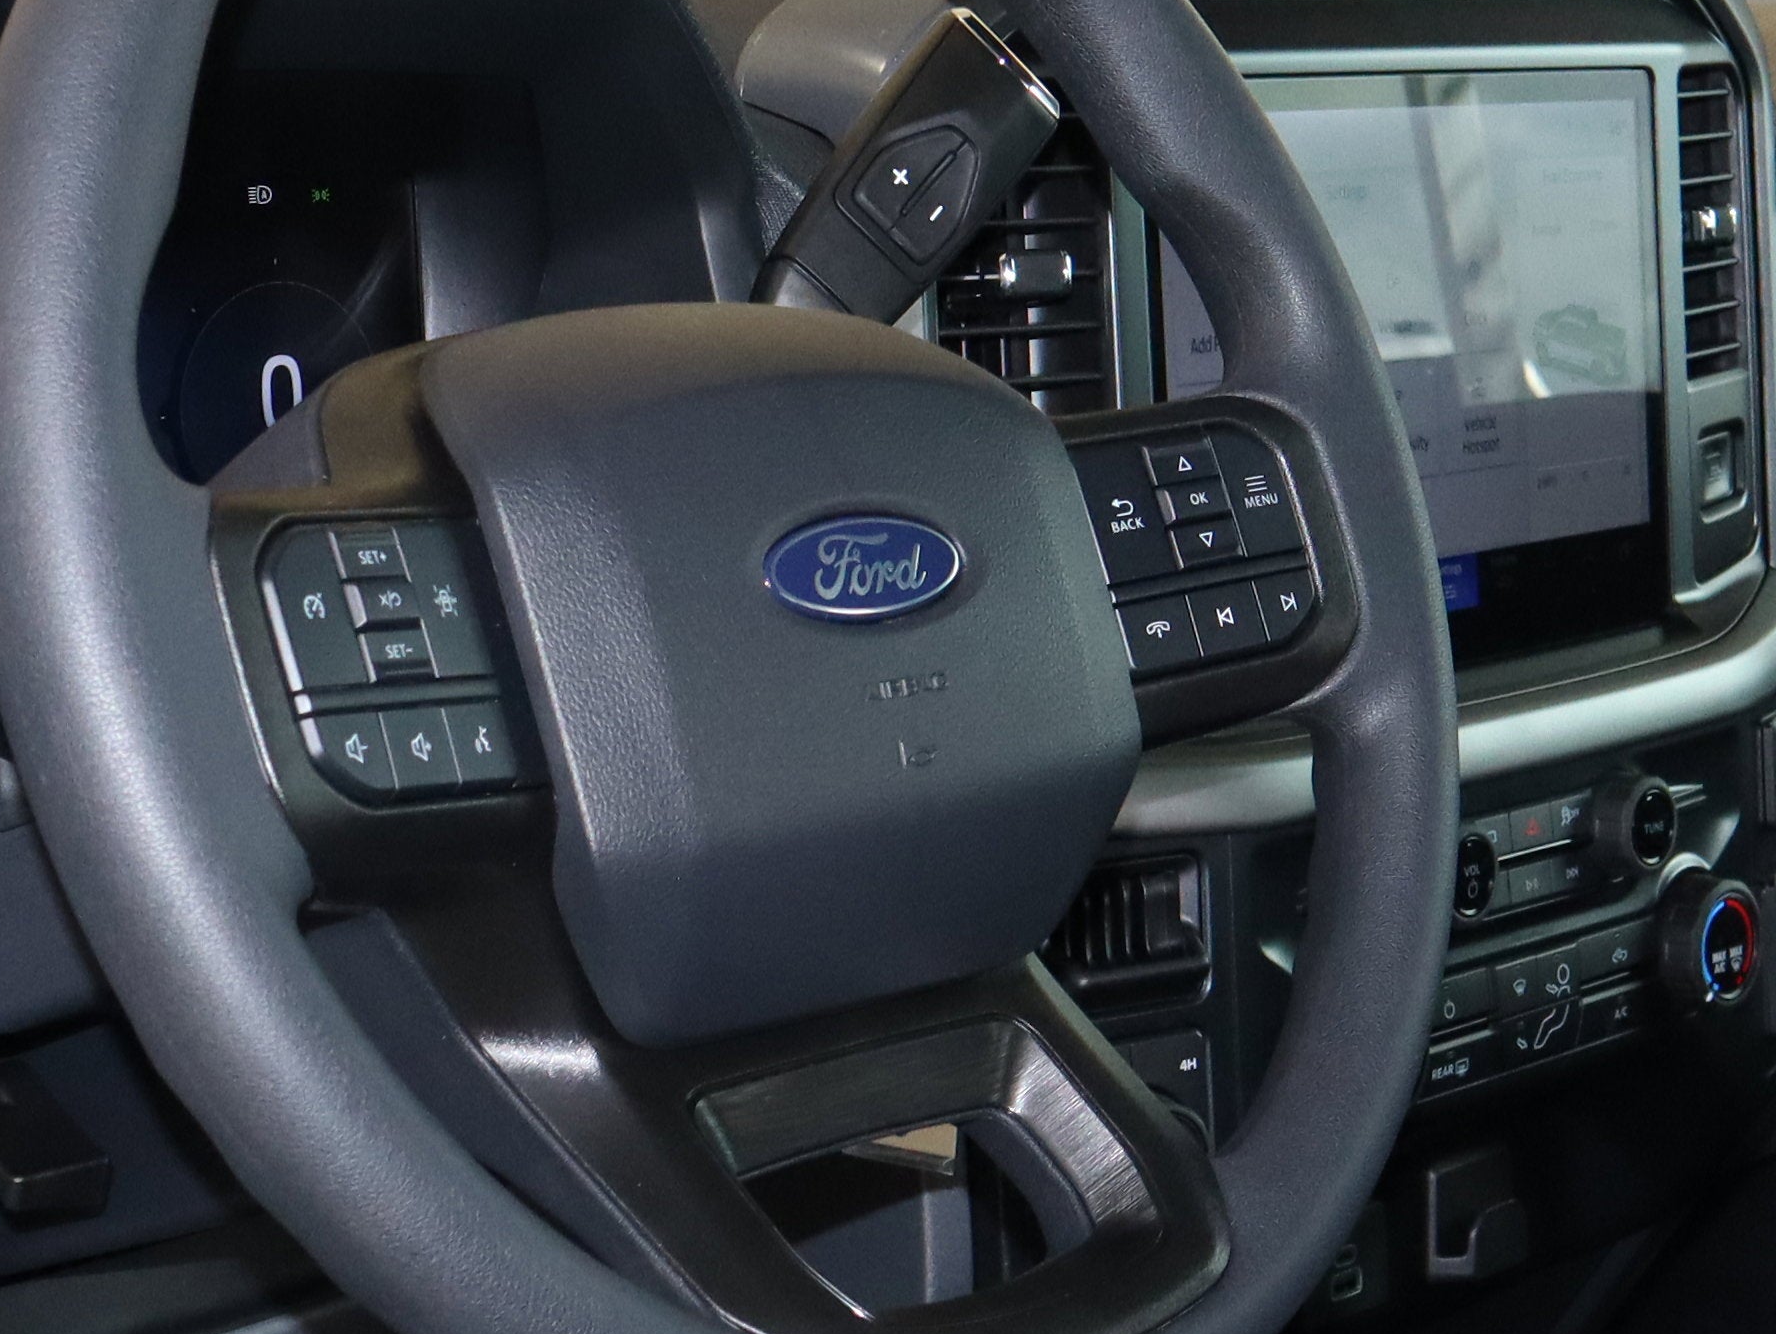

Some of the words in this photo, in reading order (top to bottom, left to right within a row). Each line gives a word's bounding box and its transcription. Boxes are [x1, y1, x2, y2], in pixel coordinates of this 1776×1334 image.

[1189, 491, 1209, 506] OK
[1243, 493, 1280, 510] MENU
[1110, 517, 1146, 534] BACK
[814, 532, 927, 601] Ford
[1644, 821, 1665, 835] TUNE
[1463, 864, 1481, 877] VOL
[1179, 1057, 1198, 1072] 4H
